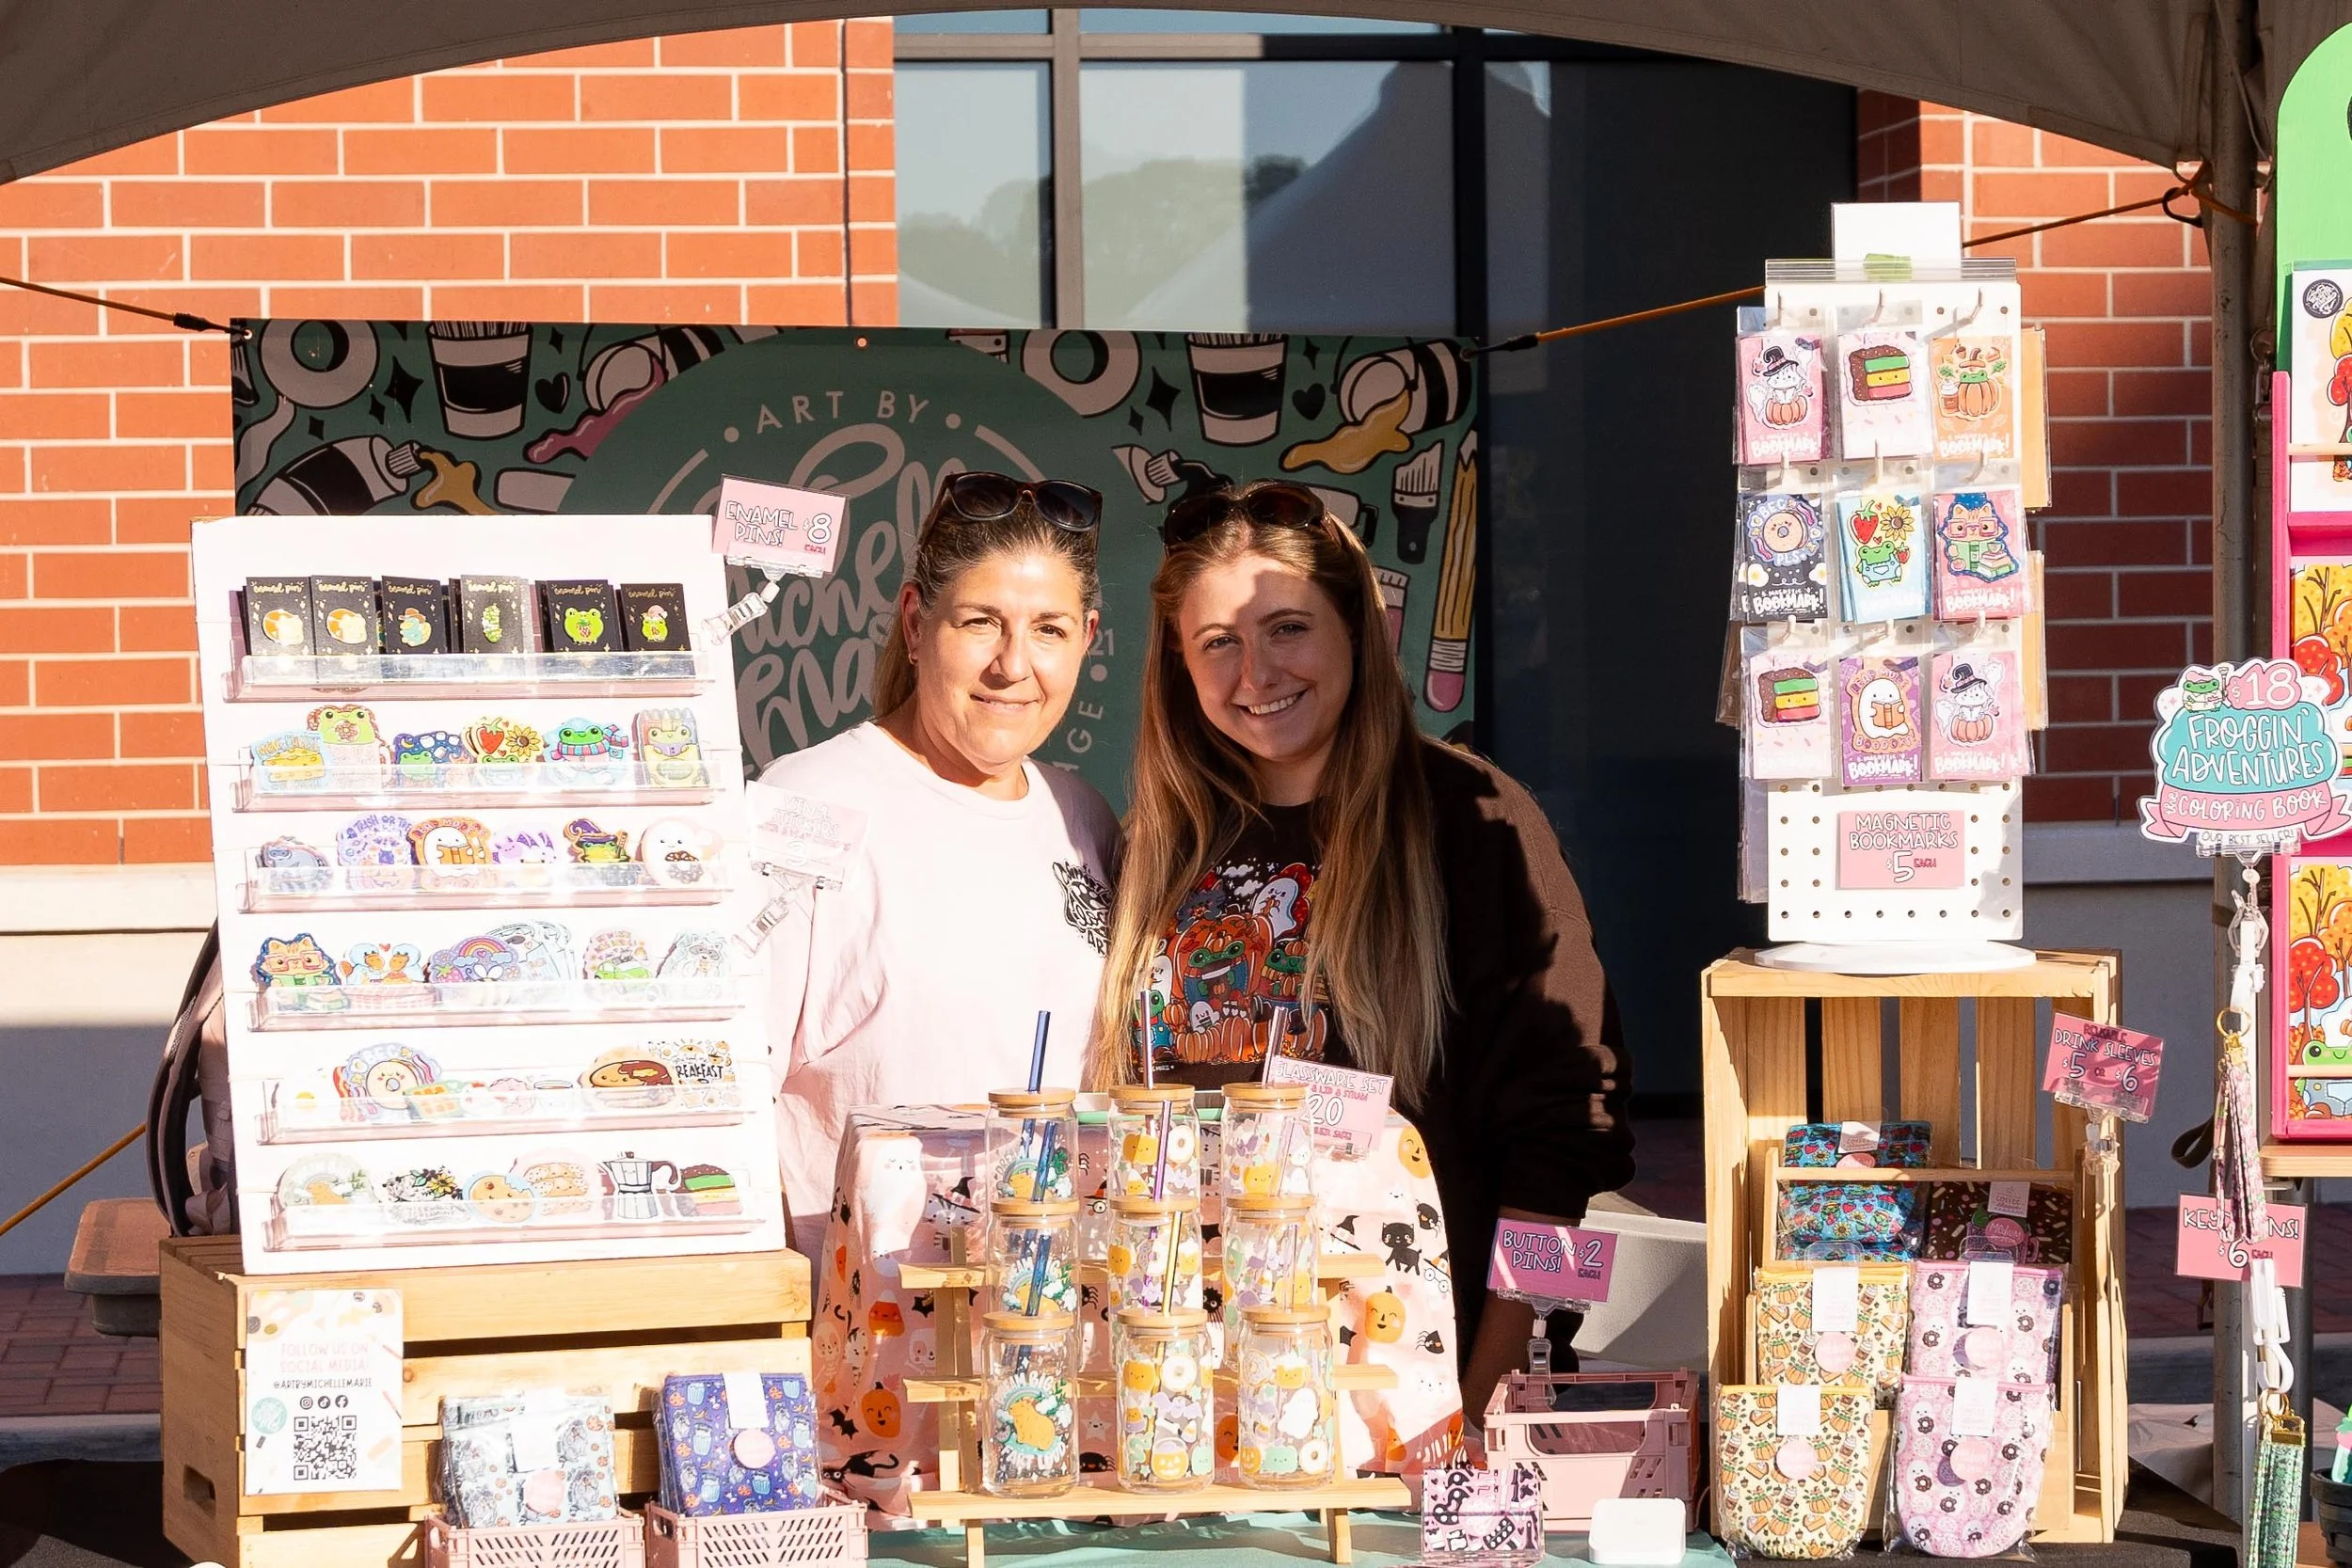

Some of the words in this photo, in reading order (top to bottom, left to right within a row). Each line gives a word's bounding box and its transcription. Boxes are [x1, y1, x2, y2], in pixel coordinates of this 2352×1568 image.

[756, 390, 844, 435] ART
[877, 390, 930, 423] BY
[725, 500, 798, 531] ENAMEL
[803, 513, 832, 544] $8
[734, 521, 786, 547] PINS!
[585, 585, 603, 596] pin
[658, 589, 675, 599] pin
[1753, 588, 1824, 614] BOOKMARK!
[1945, 587, 2015, 613] BOOKMARK!
[2231, 668, 2296, 706] $18
[2187, 707, 2310, 752] FROGGIN'
[1848, 754, 1918, 780] BOOKMARK!
[2171, 741, 2325, 787] ADVENTURES
[783, 794, 831, 819] VINYL
[2272, 788, 2328, 819] BOOK
[353, 815, 379, 832] TRASH
[381, 816, 395, 825] OR
[771, 808, 840, 837] STICKERS
[1855, 813, 1951, 832] MAGNETIC
[1850, 832, 1959, 850] BOOKMARKS
[2201, 832, 2223, 844] OUR
[2228, 832, 2254, 845] BEST
[1885, 850, 1915, 883] $5
[2055, 1028, 2100, 1053] DRINK
[2104, 1041, 2157, 1067] SLEEVES
[675, 1063, 723, 1080] REAKFAST
[2062, 1051, 2088, 1078] $5
[2120, 1064, 2143, 1093] $6
[1360, 1076, 1388, 1095] SET
[1502, 1229, 1578, 1257] BUTTON
[1579, 1239, 1604, 1268] $2
[1512, 1250, 1563, 1273] PINS!
[2217, 1238, 2249, 1268] $6
[280, 1342, 329, 1357] FOLLOW
[332, 1342, 347, 1355] US
[351, 1342, 369, 1355] ON
[280, 1358, 323, 1373] SOCIAL
[273, 1377, 373, 1389] @ARTBYMICHELLEMARIE
